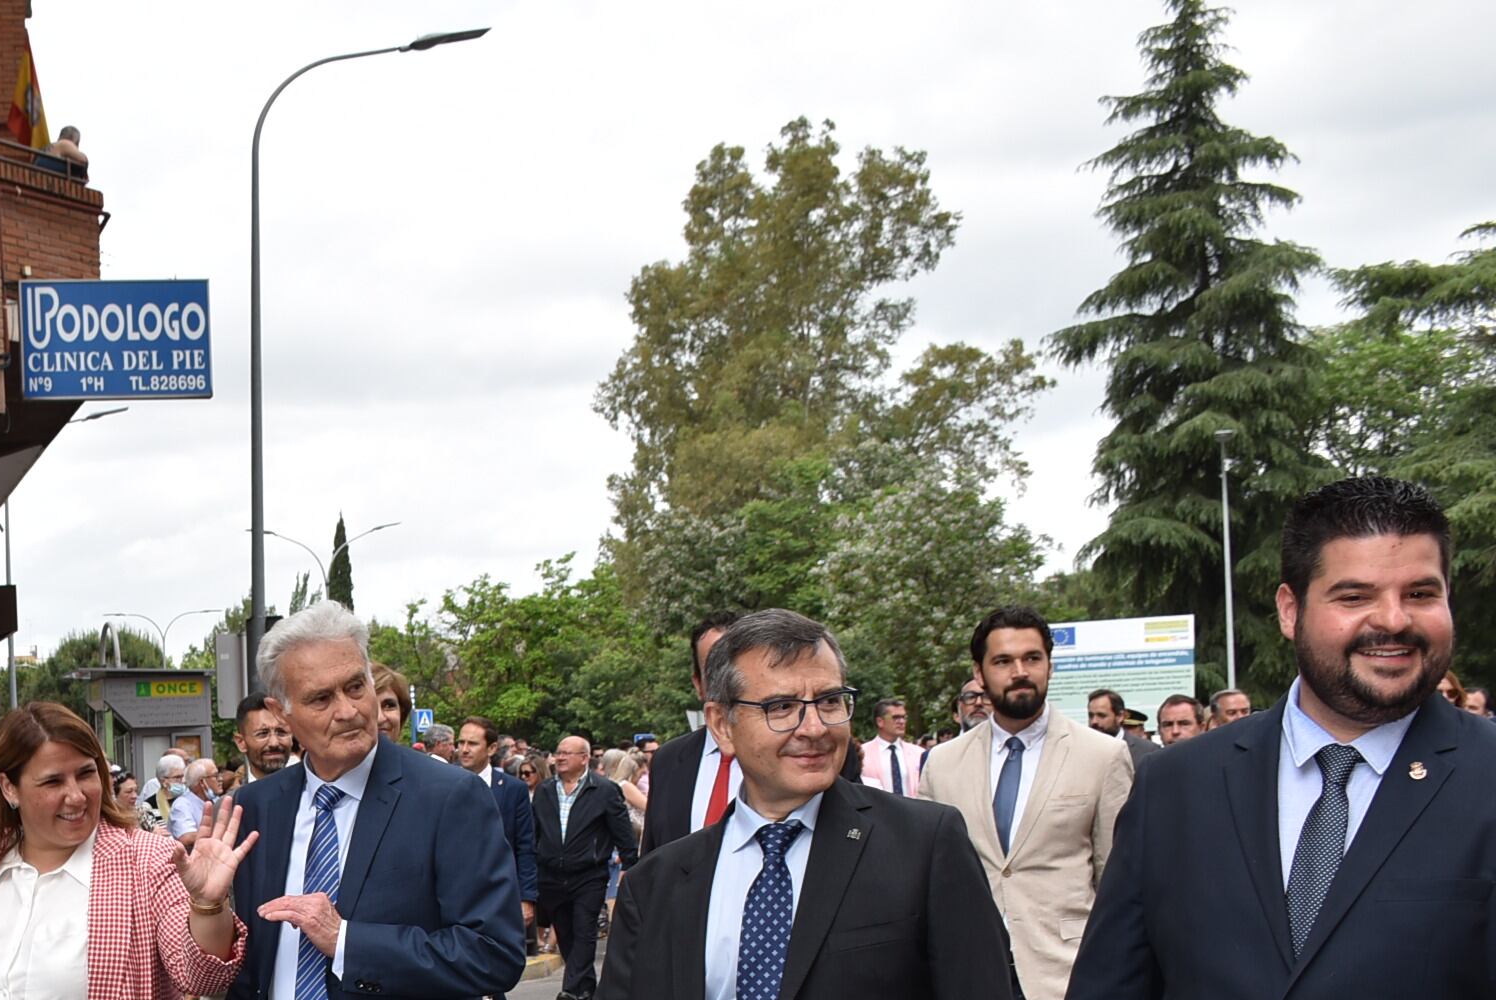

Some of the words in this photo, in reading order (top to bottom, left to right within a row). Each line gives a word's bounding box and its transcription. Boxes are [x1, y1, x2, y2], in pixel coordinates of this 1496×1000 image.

[27, 286, 205, 350] PODOLOGO
[28, 351, 114, 372] CLINICA
[123, 350, 164, 370] DEL
[173, 349, 205, 370] PIE
[129, 375, 205, 391] TL.828696
[155, 682, 197, 694] ONCE
